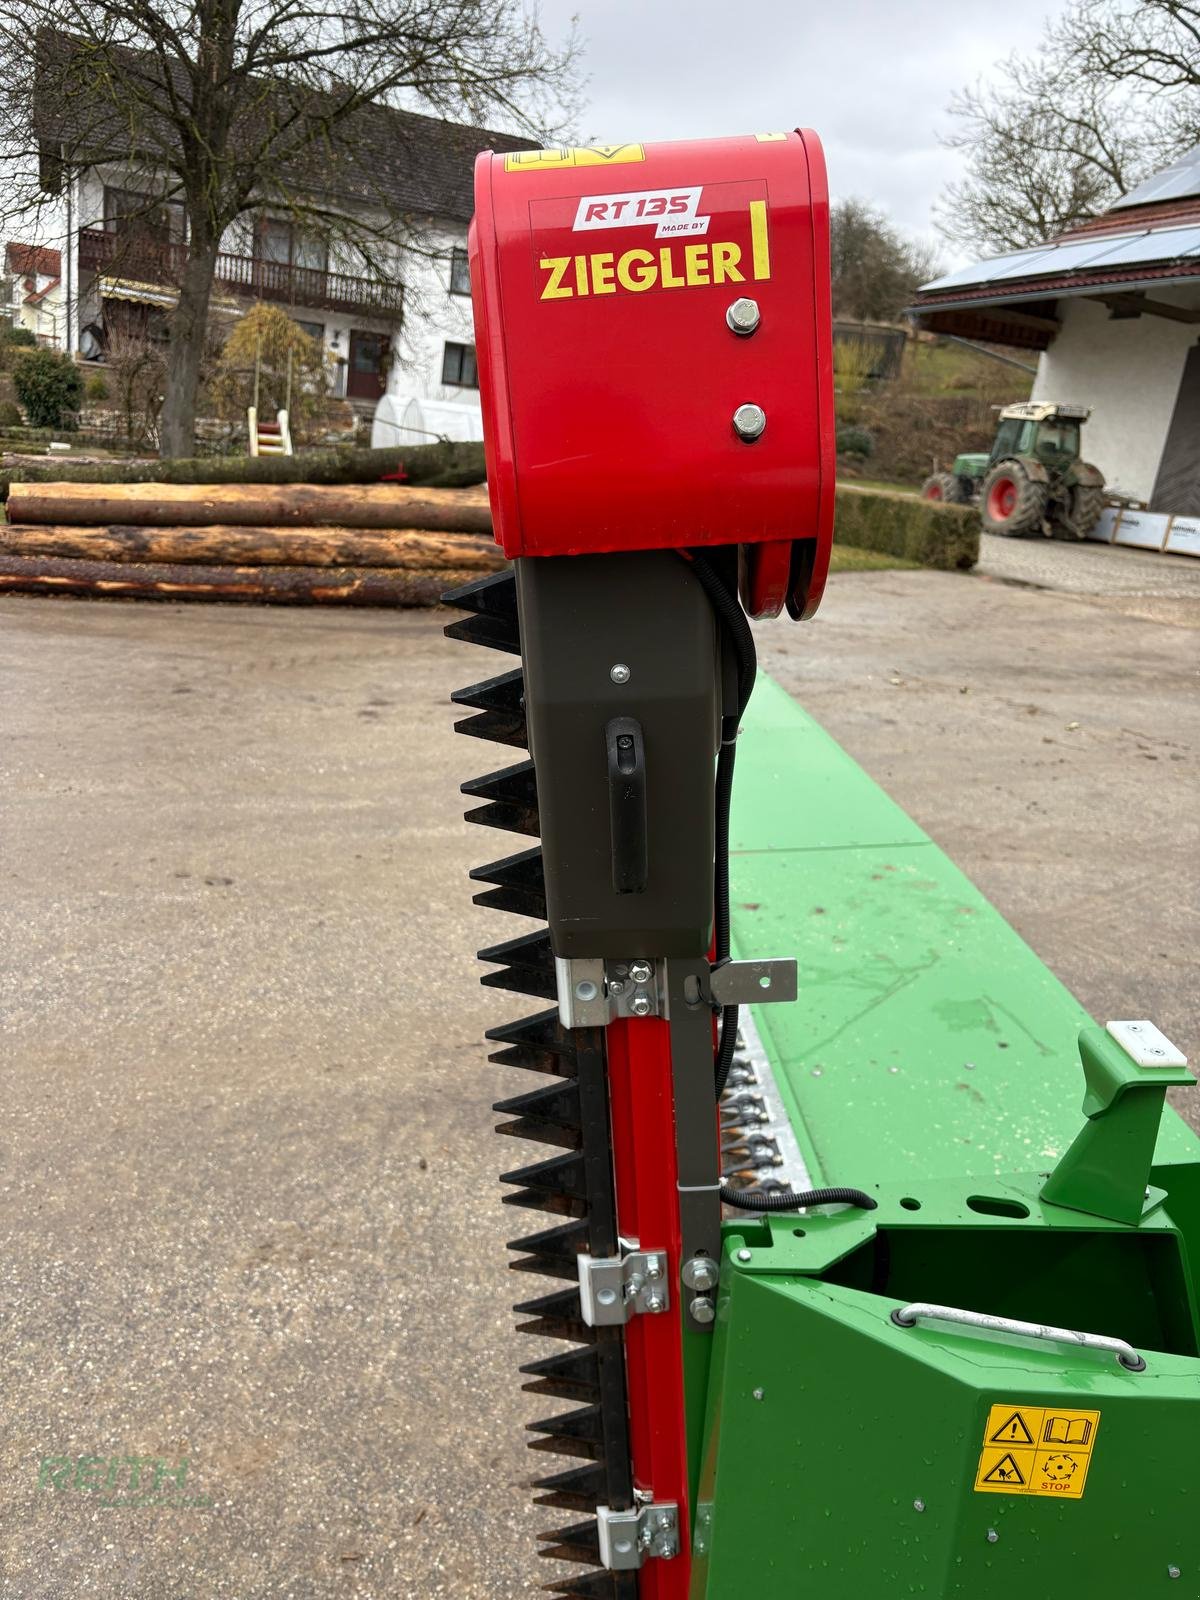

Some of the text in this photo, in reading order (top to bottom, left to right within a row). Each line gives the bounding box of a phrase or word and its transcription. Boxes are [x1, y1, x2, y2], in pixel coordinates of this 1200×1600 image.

[585, 195, 692, 221] RT 135
[661, 222, 705, 232] MADE BY
[540, 242, 745, 299] ZIEGLER
[1041, 1482, 1070, 1490] STOP
